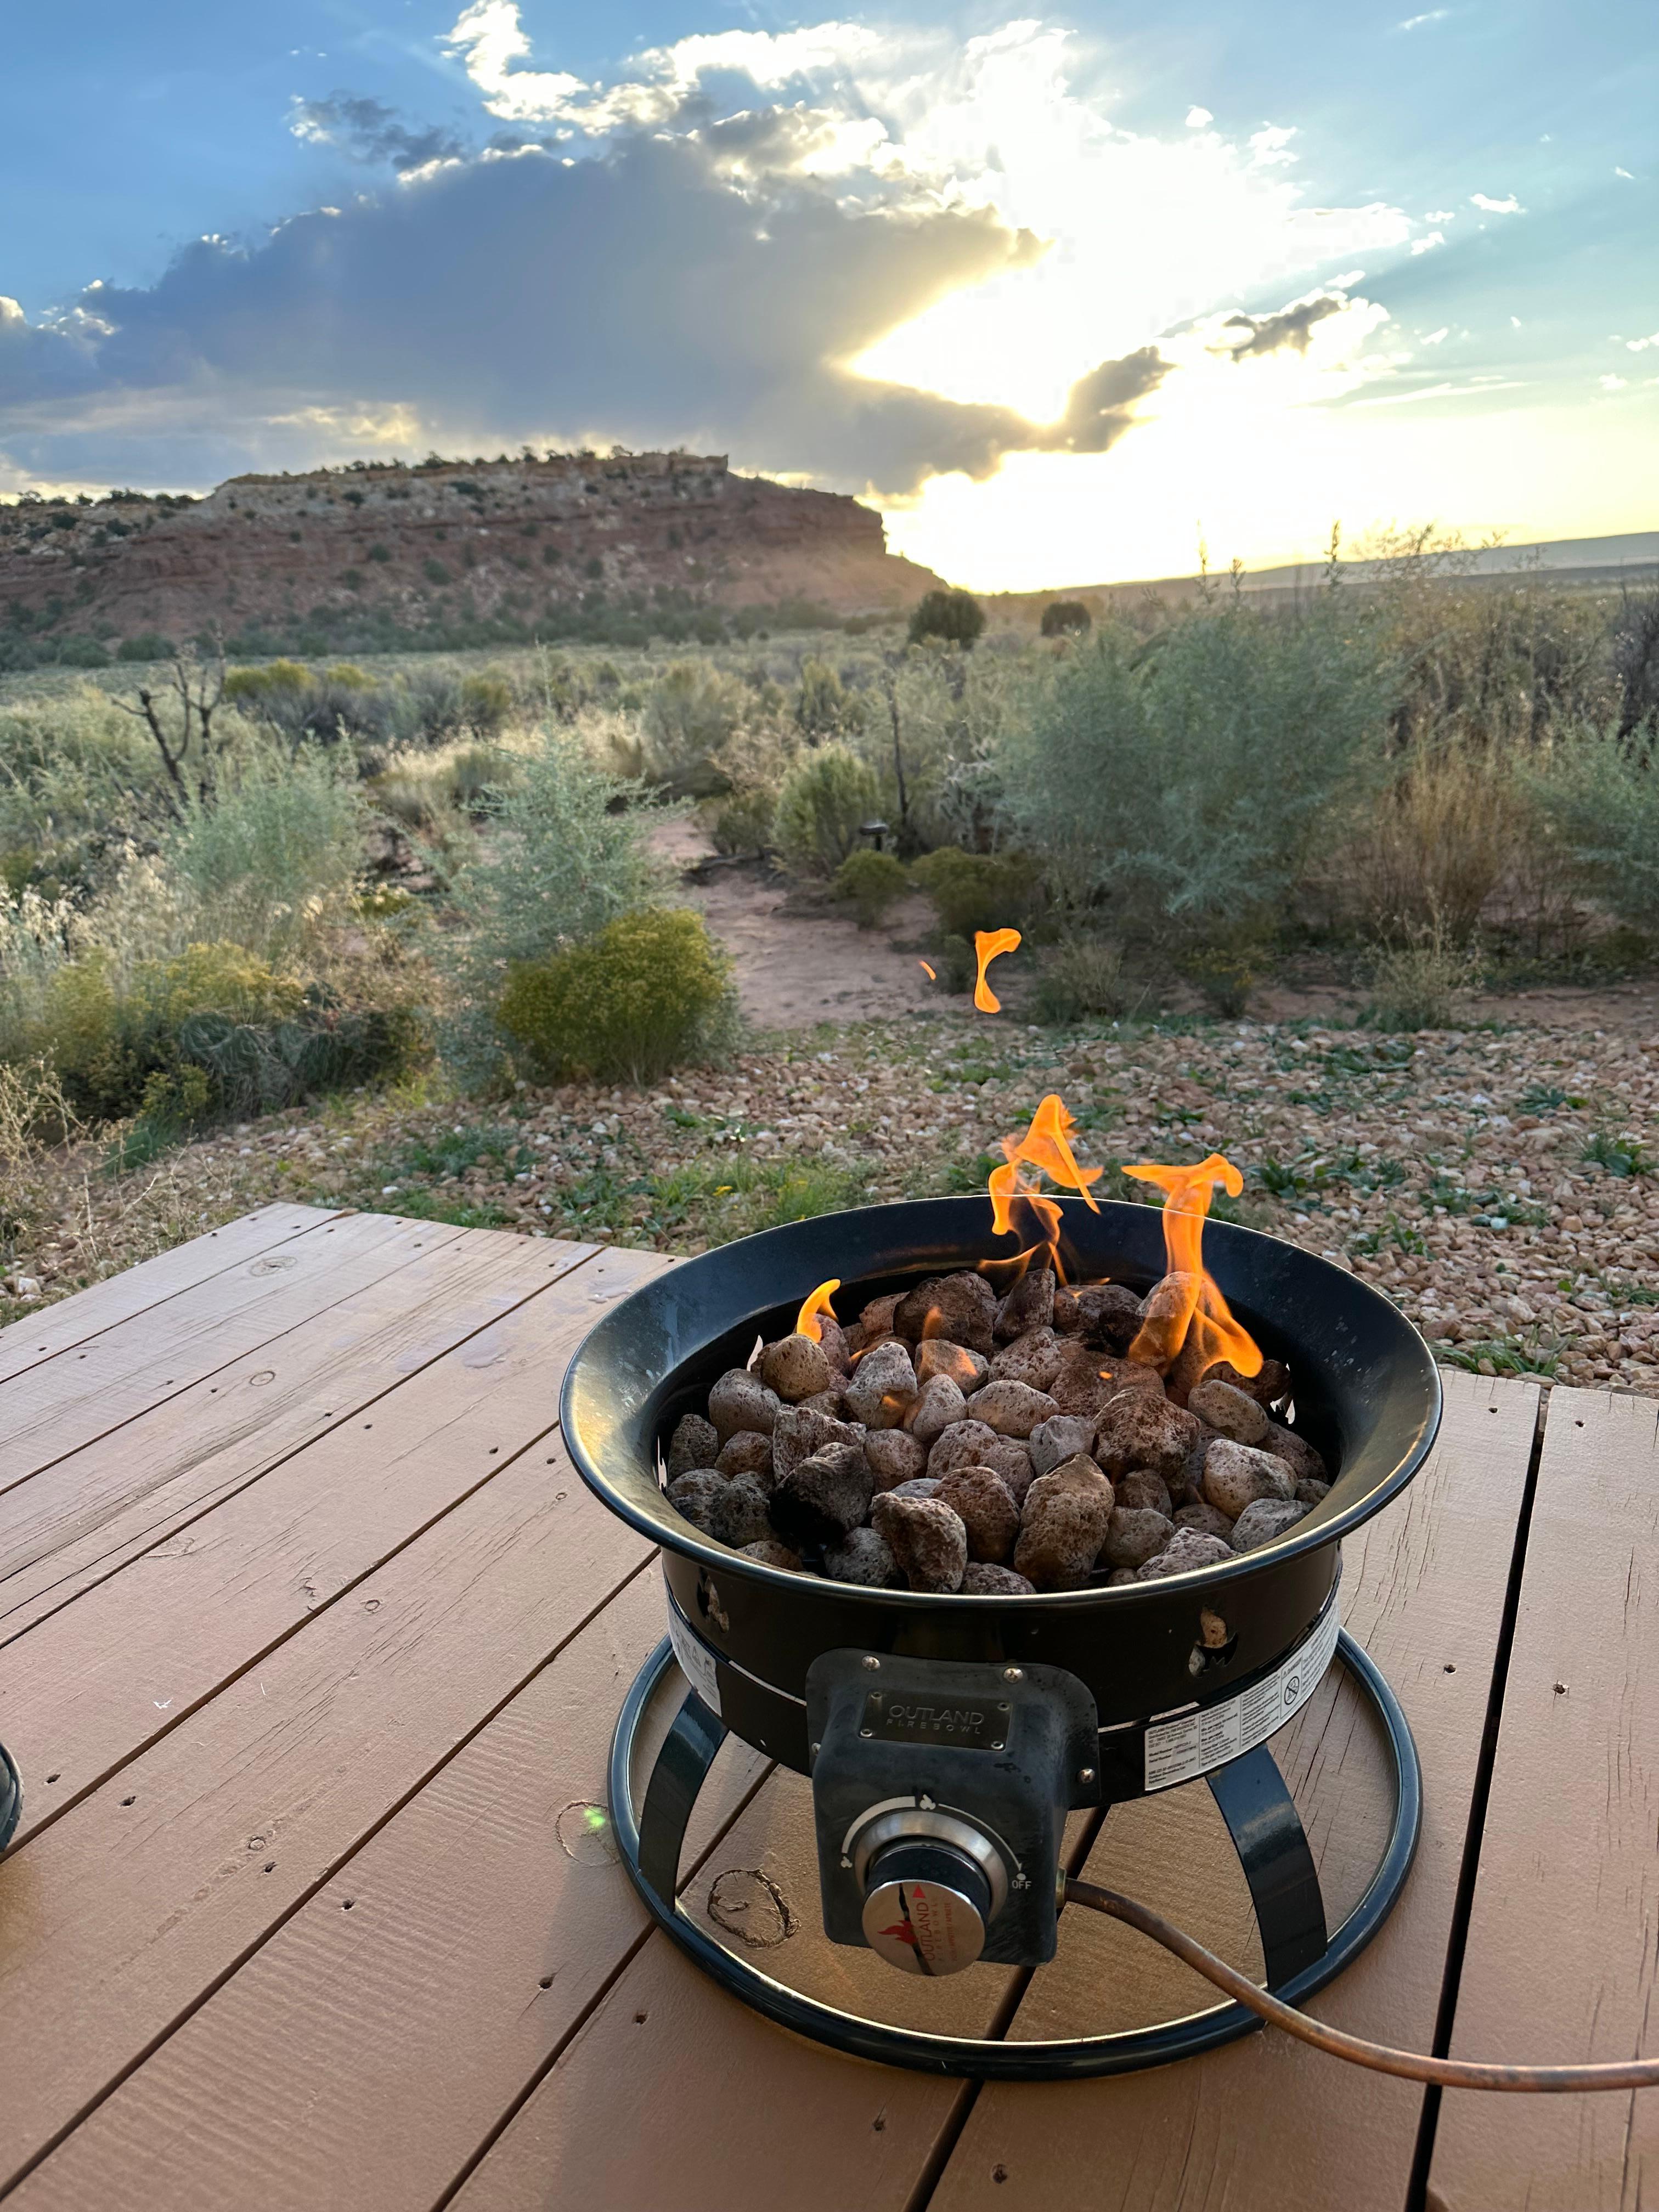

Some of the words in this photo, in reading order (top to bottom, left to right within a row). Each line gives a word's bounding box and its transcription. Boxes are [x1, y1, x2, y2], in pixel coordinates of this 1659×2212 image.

[889, 1705, 985, 1725] OUTLAND
[886, 1719, 981, 1734] FIREBOWL
[1012, 1880, 1032, 1889] OFF
[916, 1902, 935, 1961] OUTLAND
